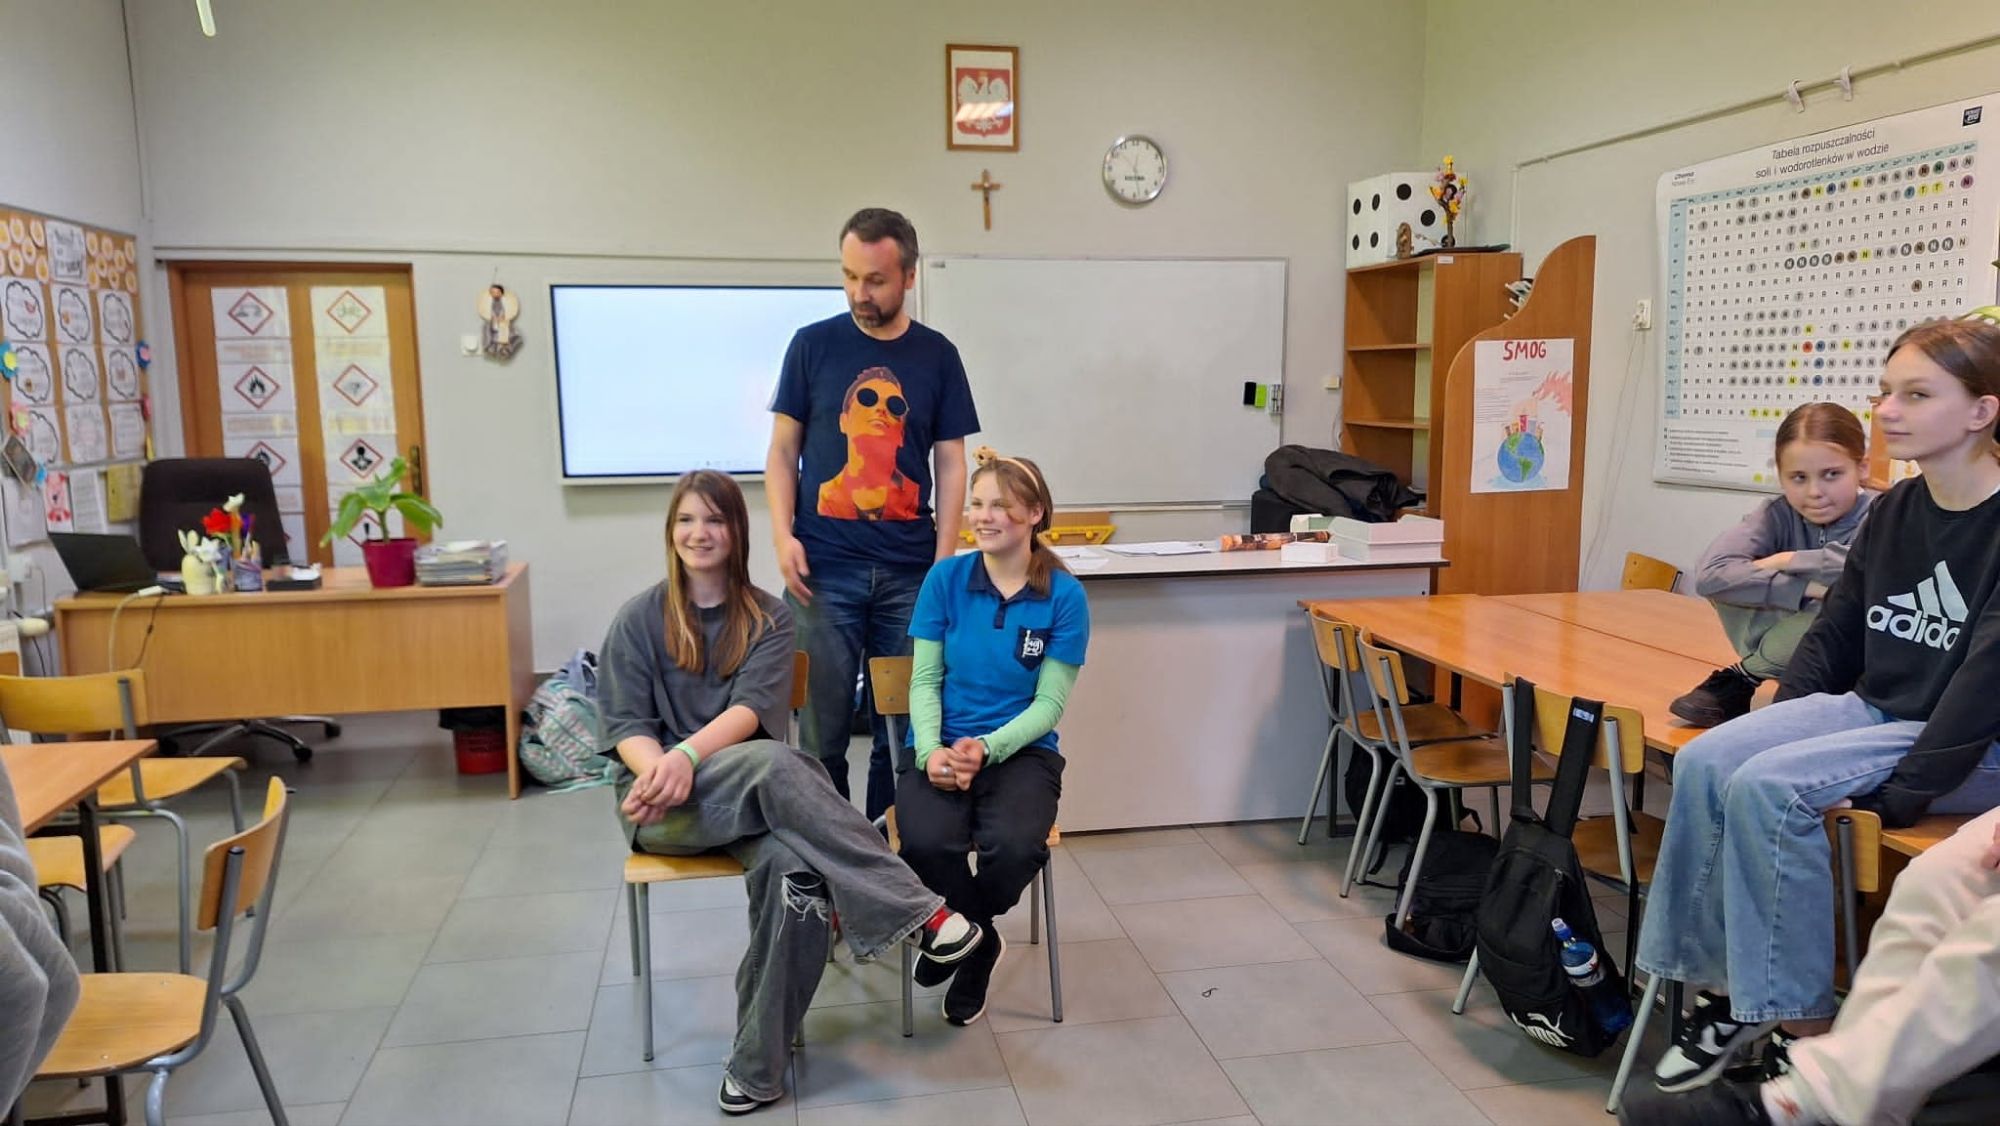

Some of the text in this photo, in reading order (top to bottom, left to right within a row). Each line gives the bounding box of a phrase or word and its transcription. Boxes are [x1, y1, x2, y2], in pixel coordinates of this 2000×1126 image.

[1755, 168, 1772, 179] soli
[1780, 153, 1845, 174] wodorotlenków
[1857, 143, 1890, 158] wodzie
[1772, 128, 1875, 160] Tabela rozpuszczalności
[1503, 341, 1547, 361] SMOG
[1866, 605, 1961, 652] adida
